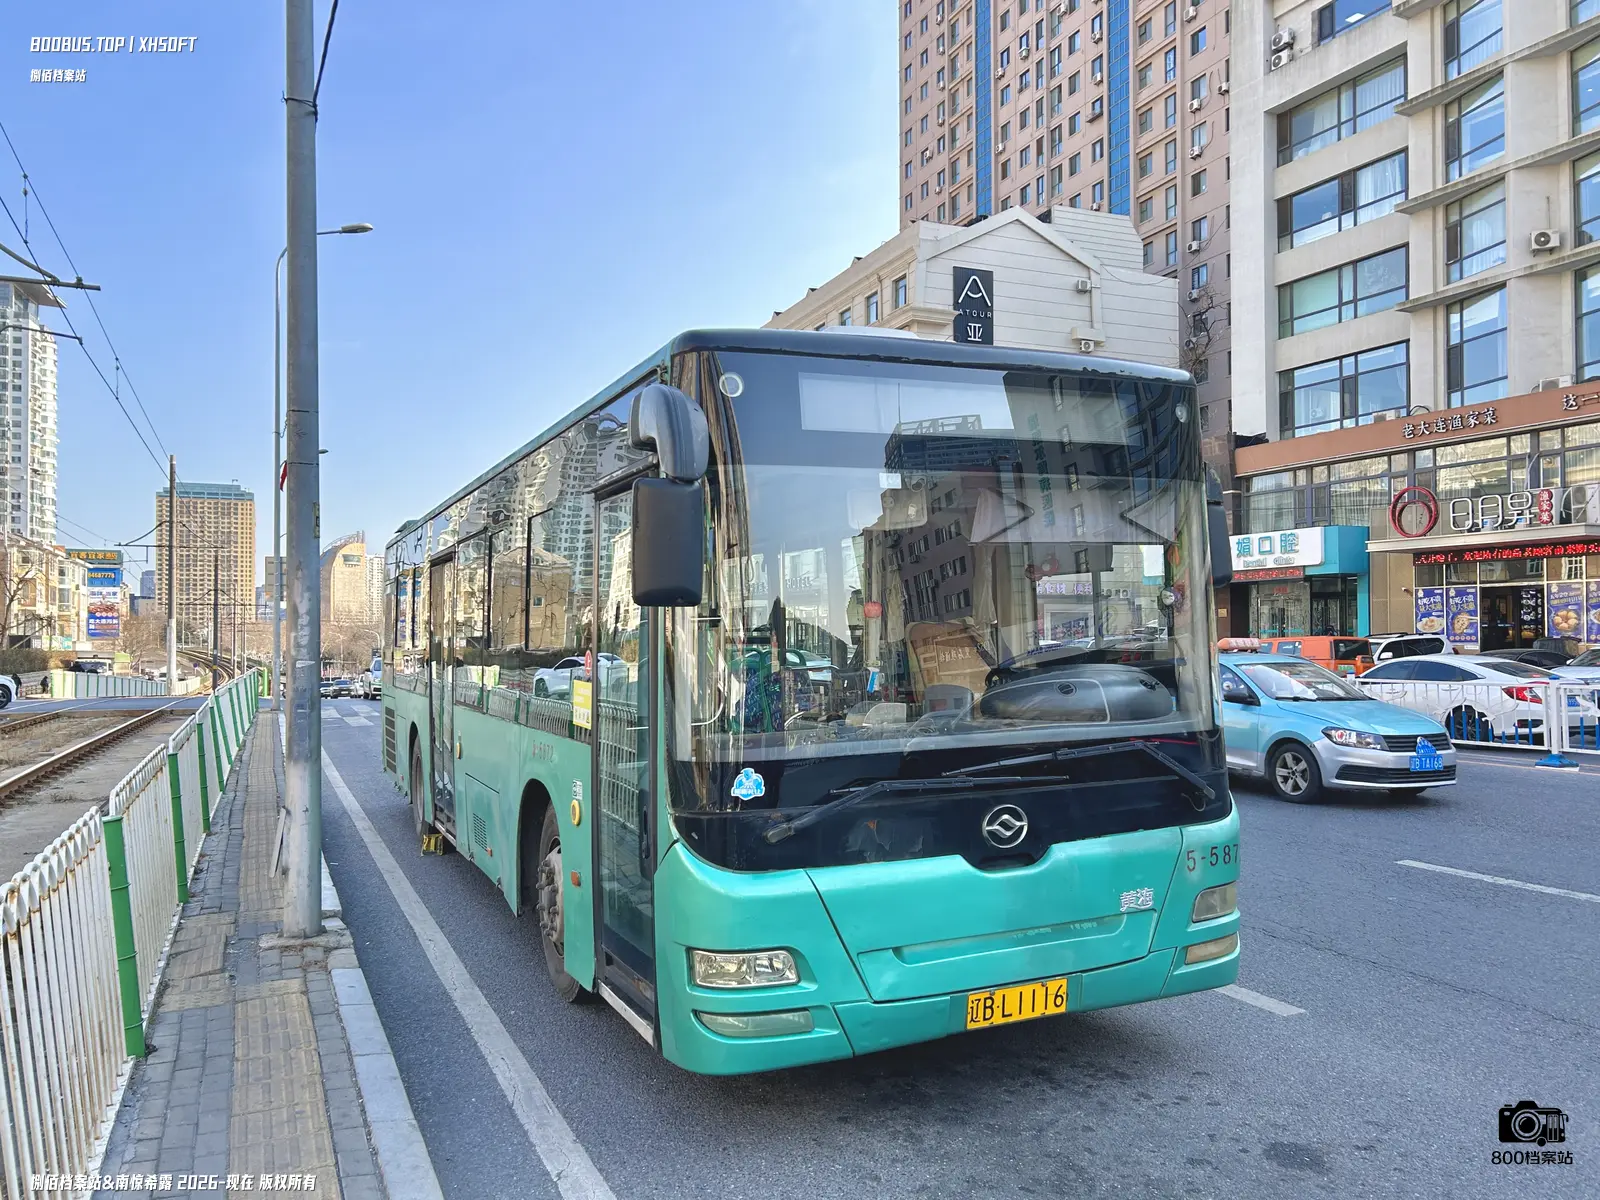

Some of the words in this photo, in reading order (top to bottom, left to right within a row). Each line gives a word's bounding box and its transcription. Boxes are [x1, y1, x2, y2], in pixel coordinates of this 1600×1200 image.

[959, 308, 992, 318] ATOUR
[1402, 406, 1499, 440] 老大连渔家菜
[1538, 489, 1554, 525] 渔家菜
[1235, 532, 1300, 559] 娟口腔
[1119, 887, 1155, 912] 黄海
